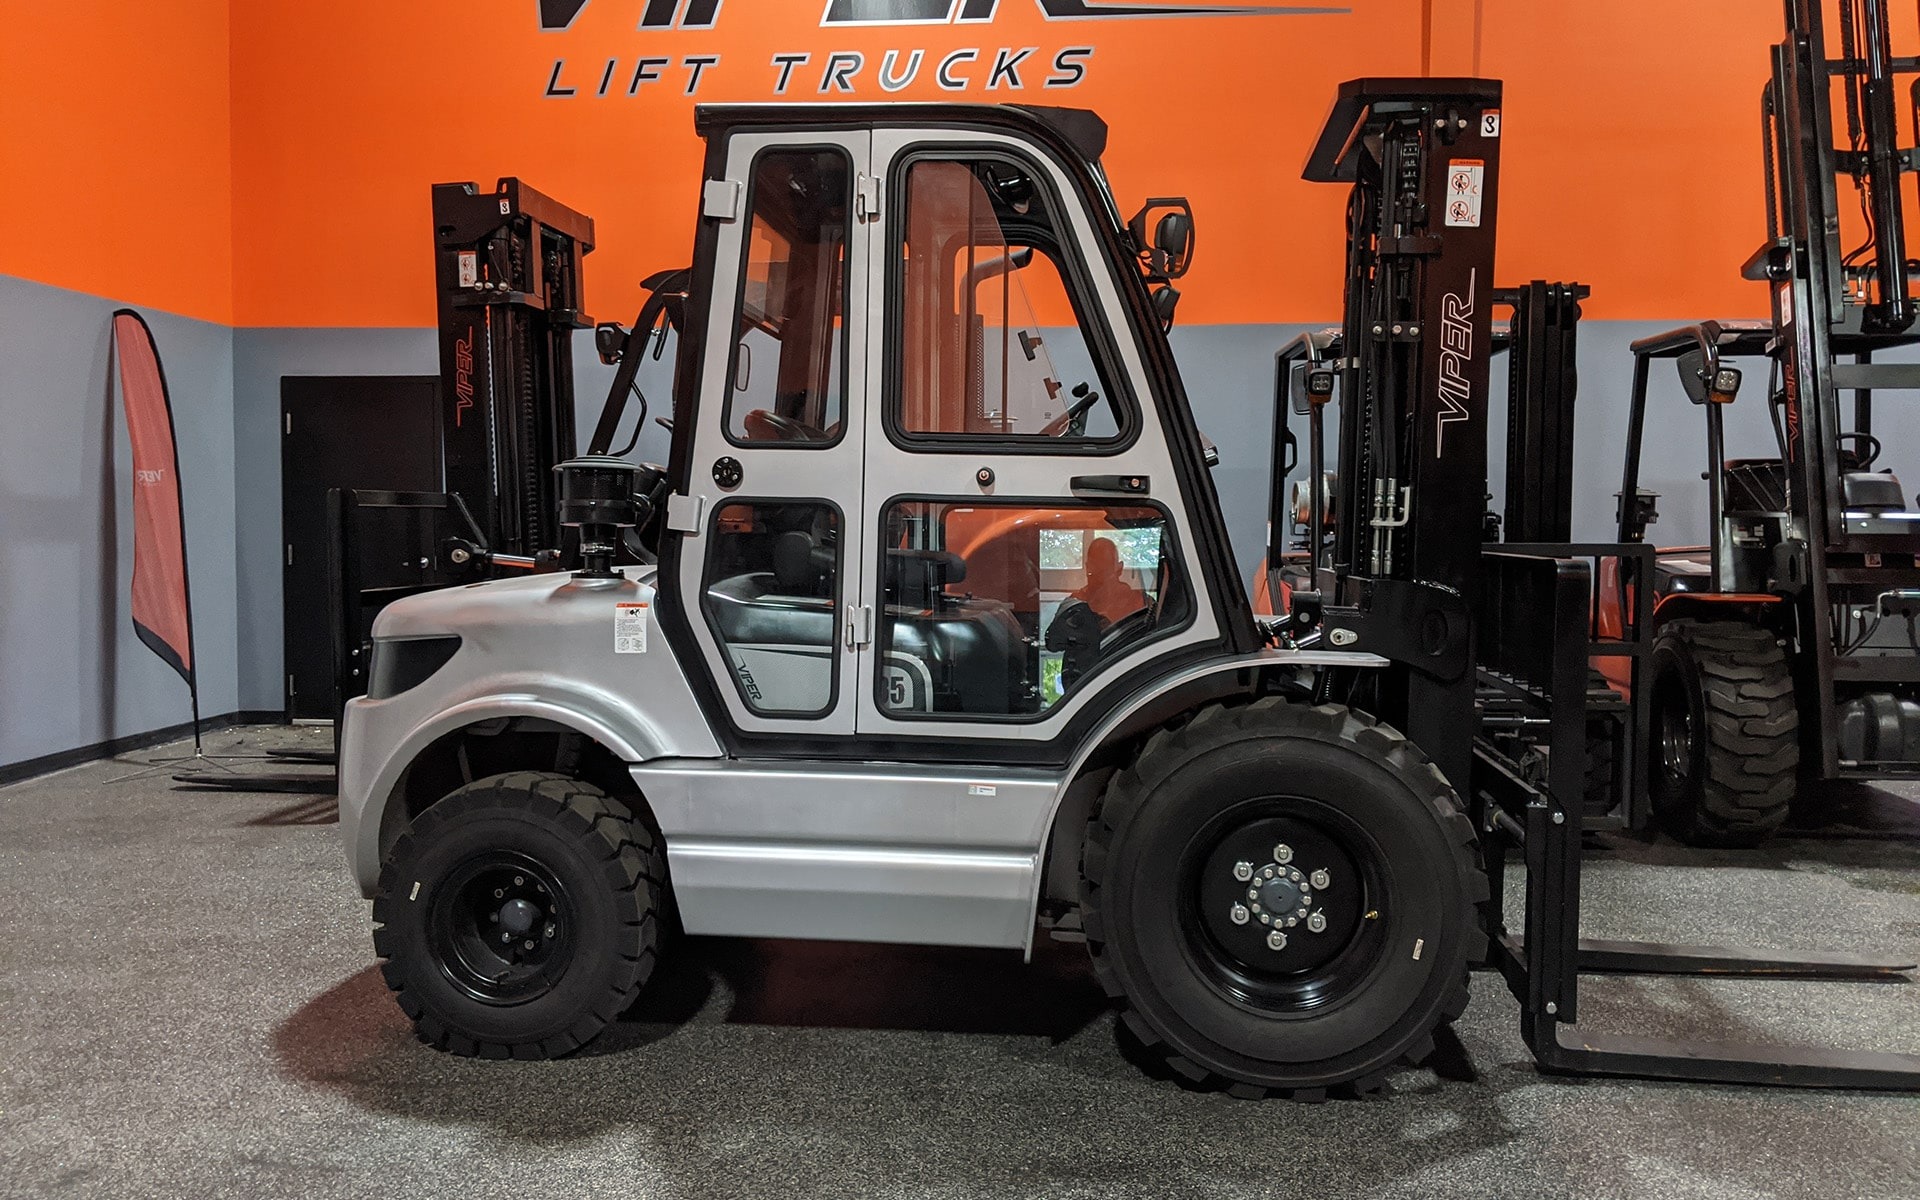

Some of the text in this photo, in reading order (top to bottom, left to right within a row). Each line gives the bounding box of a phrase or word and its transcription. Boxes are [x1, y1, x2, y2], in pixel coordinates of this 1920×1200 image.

[544, 46, 1095, 97] LIFT TRUCKS
[456, 325, 473, 427] VIPER
[1437, 267, 1475, 459] VIPER
[738, 655, 763, 702] VIPER
